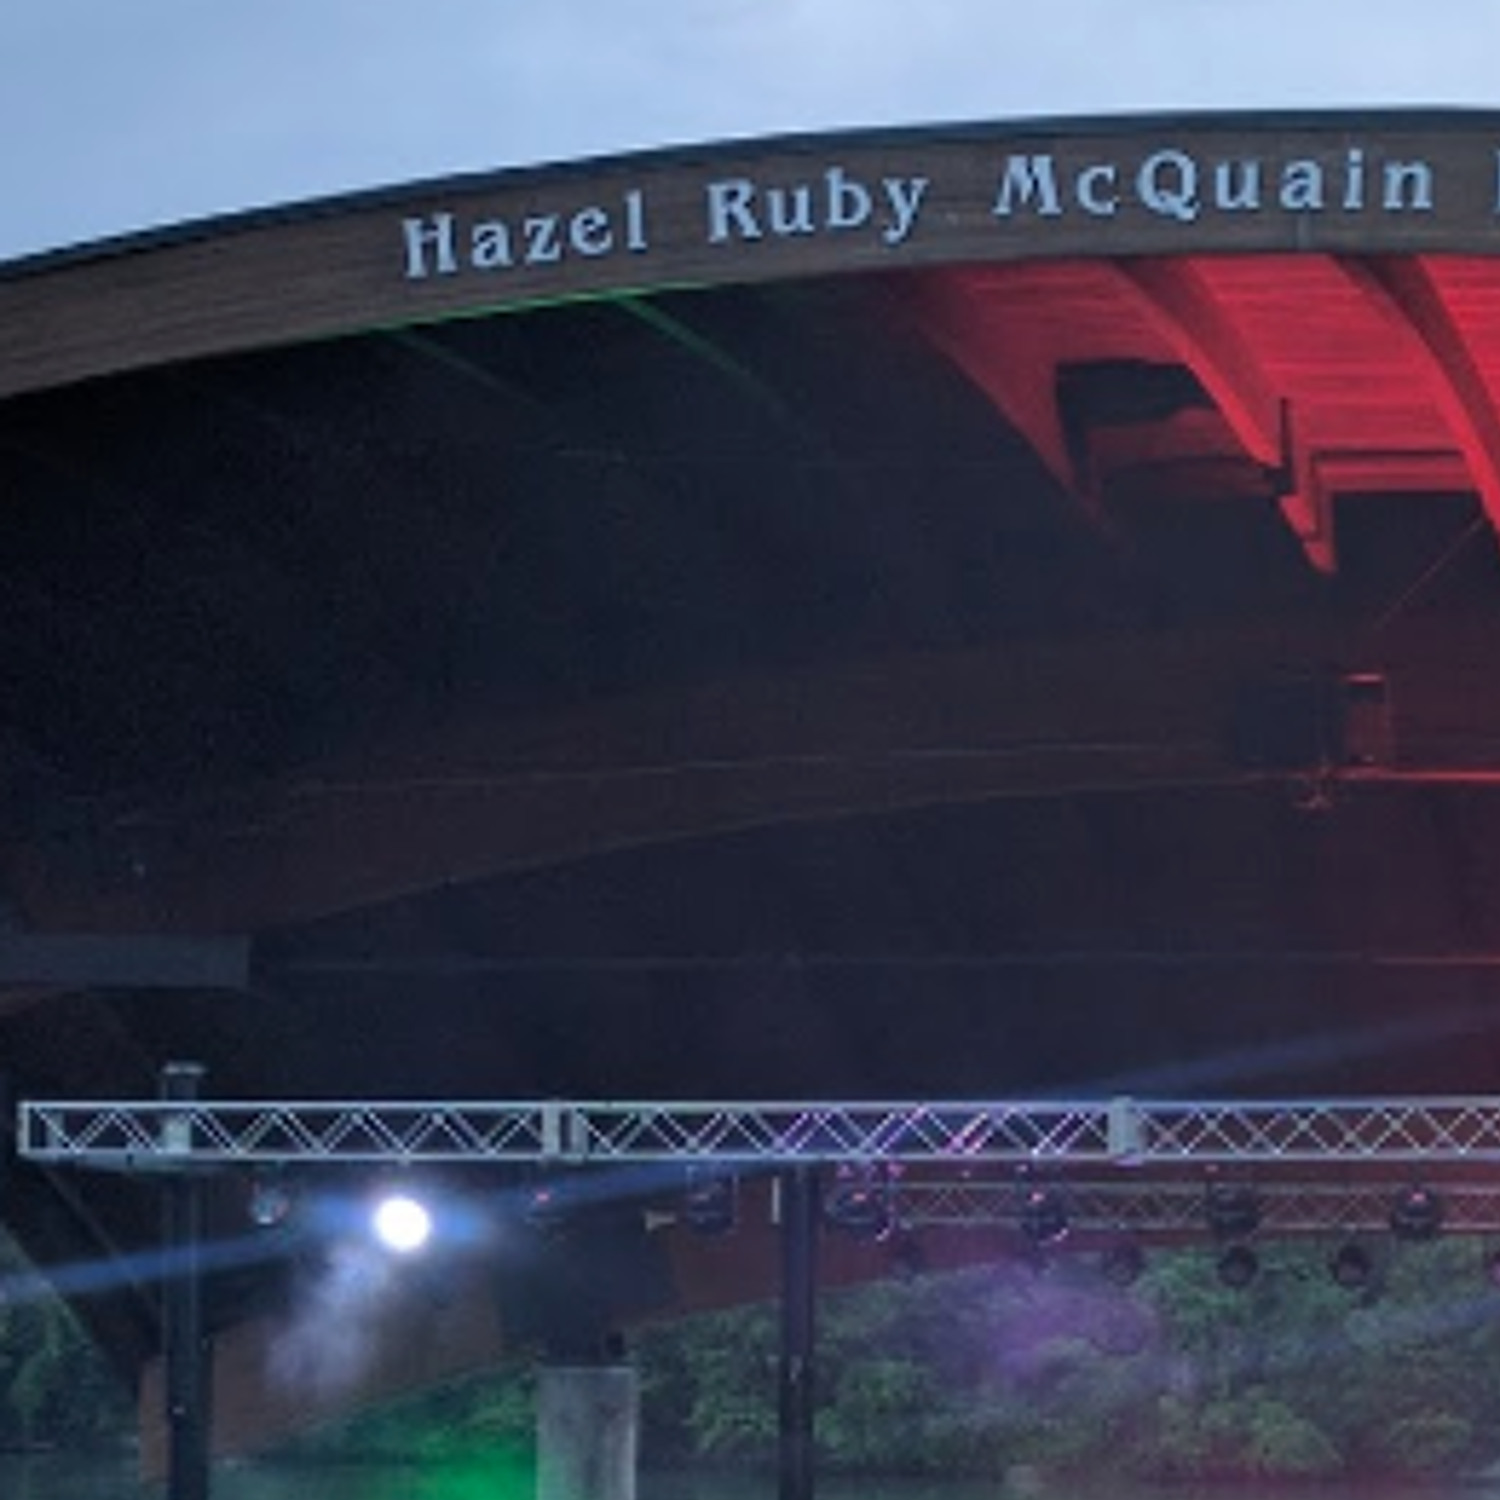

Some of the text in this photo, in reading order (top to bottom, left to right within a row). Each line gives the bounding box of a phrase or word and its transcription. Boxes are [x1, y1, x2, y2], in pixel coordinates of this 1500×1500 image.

[403, 190, 647, 278] Hazel
[707, 167, 929, 243] Ruby
[993, 148, 1432, 221] McQuain
